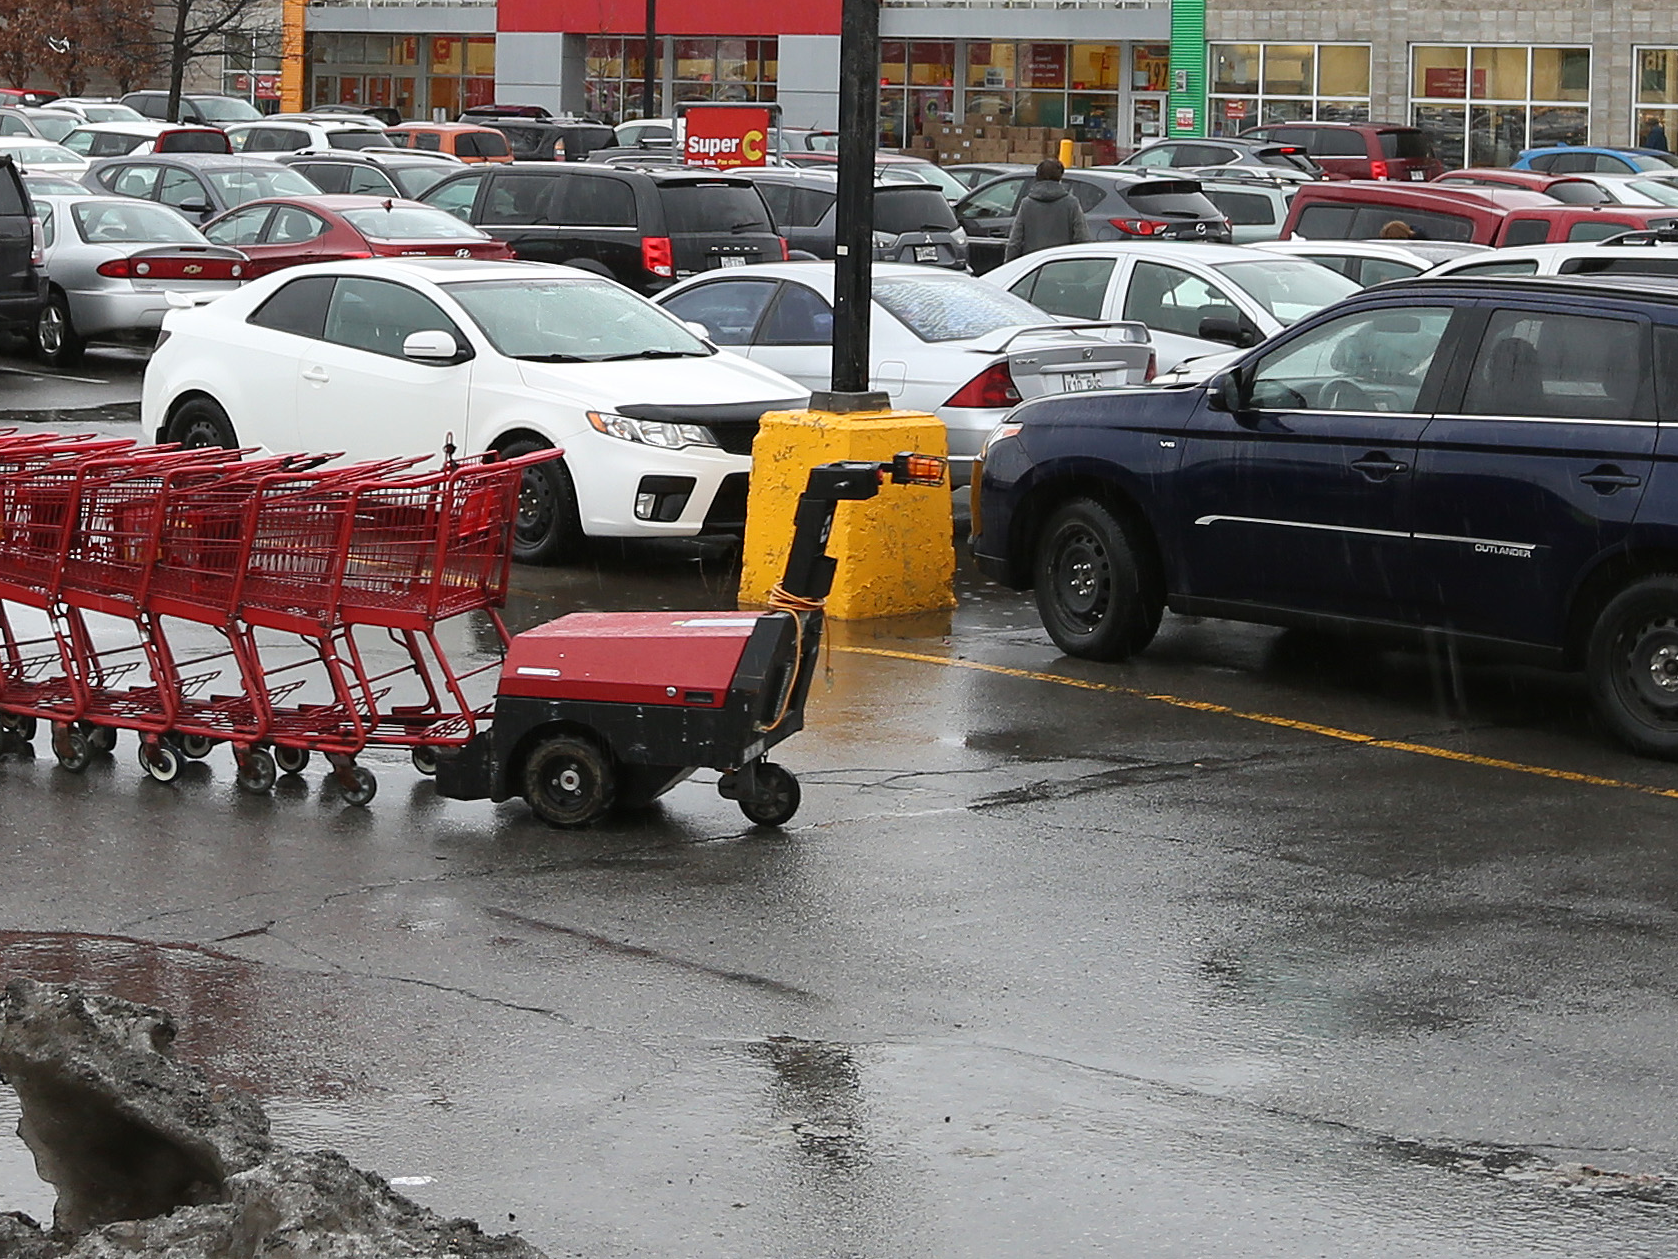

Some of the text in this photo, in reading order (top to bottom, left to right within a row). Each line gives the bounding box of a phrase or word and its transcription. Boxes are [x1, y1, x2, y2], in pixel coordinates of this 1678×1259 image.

[688, 130, 764, 161] Super C
[1474, 543, 1532, 558] OUTLANDER
